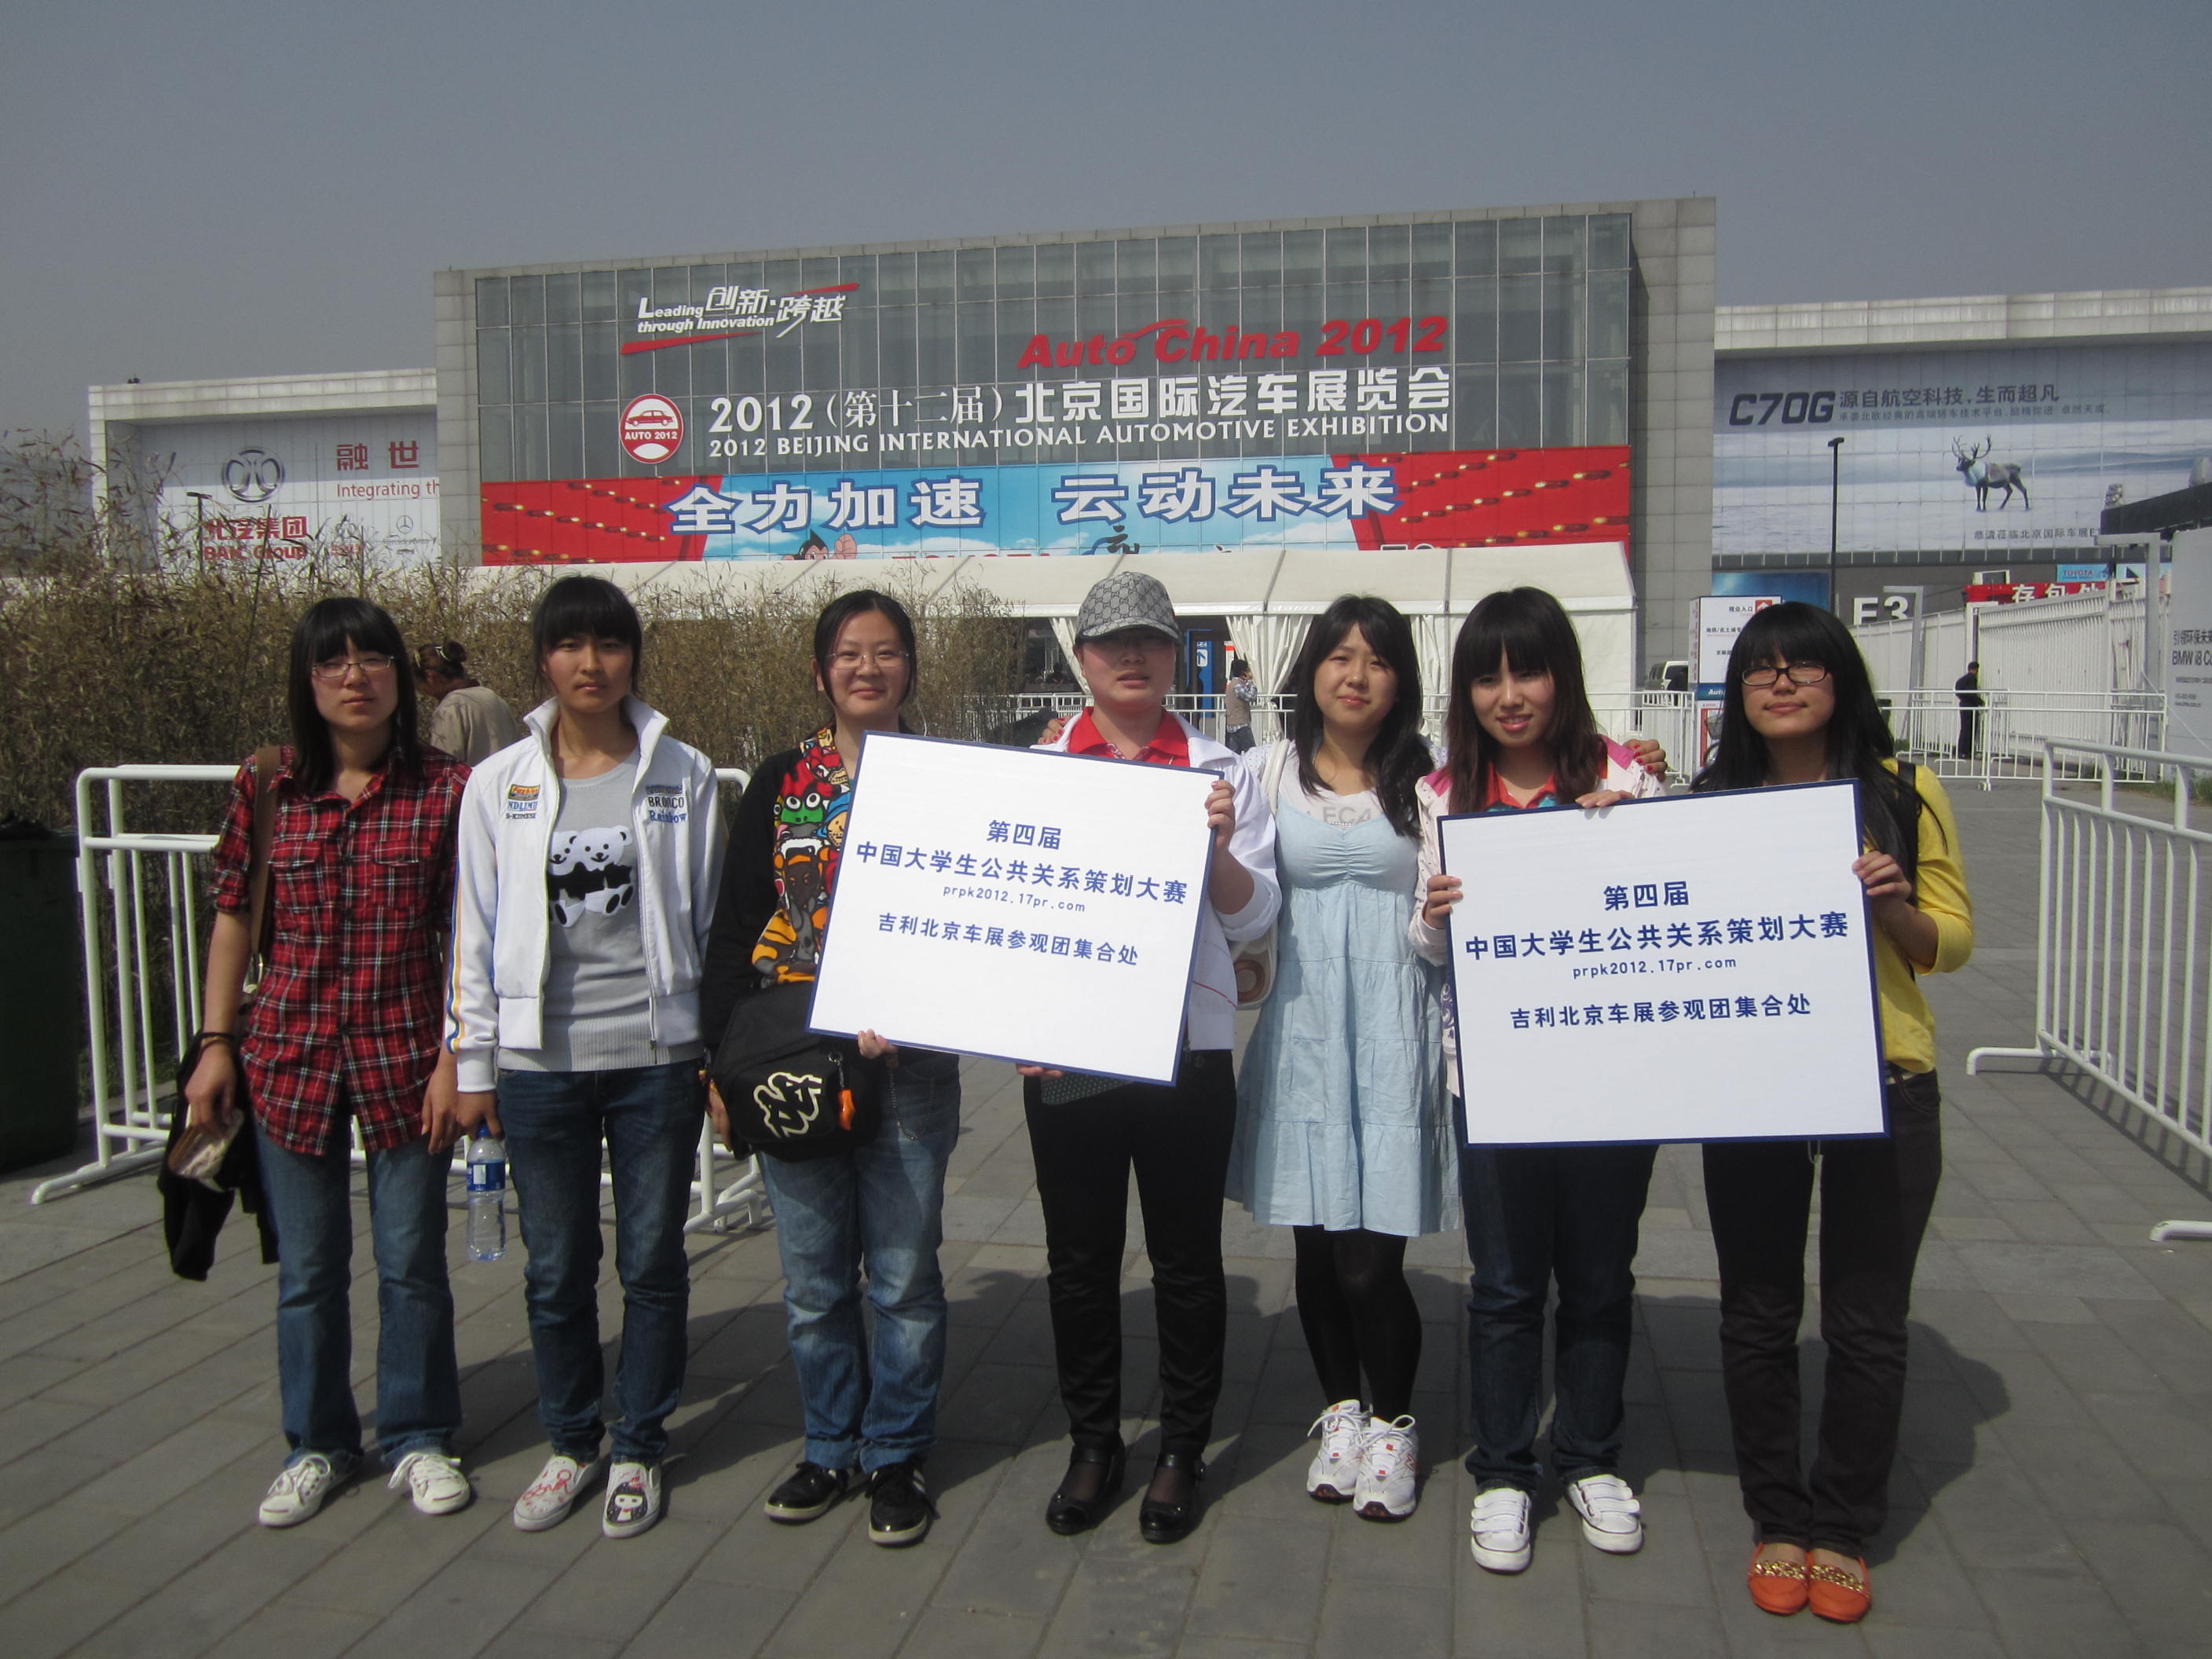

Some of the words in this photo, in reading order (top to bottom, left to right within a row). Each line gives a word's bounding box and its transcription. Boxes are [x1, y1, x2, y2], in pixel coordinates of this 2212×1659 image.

[637, 297, 704, 319] Leading
[637, 320, 693, 334] through
[697, 315, 775, 330] Innovation
[1017, 333, 1137, 368] Auto
[1155, 319, 1301, 363] China
[1315, 316, 1448, 357] 2012
[1729, 391, 1836, 425] C70G
[624, 431, 652, 440] AUTO
[654, 430, 678, 440] 2012
[709, 438, 767, 458] 2012
[777, 434, 869, 457] BEIJING
[879, 427, 1086, 452] INTERNATIONAL
[1097, 419, 1276, 444] AUTOMOTIVE
[1287, 413, 1448, 438] EXHIBITION
[337, 481, 420, 501] Integrating
[665, 476, 986, 534] 全力加速
[1053, 463, 1401, 524] 云动未来
[2172, 650, 2193, 665] BMW
[987, 819, 1062, 850] 第四届
[856, 841, 1188, 904] 中国大学生公共关系策划大赛
[1603, 881, 1690, 911] 第四届
[877, 913, 1139, 966] 吉利北京车展参观团集合处
[1465, 911, 1849, 961] 中国大学生公共关系策划大赛
[1509, 993, 1811, 1030] 吉利北京车展参观团集合处
